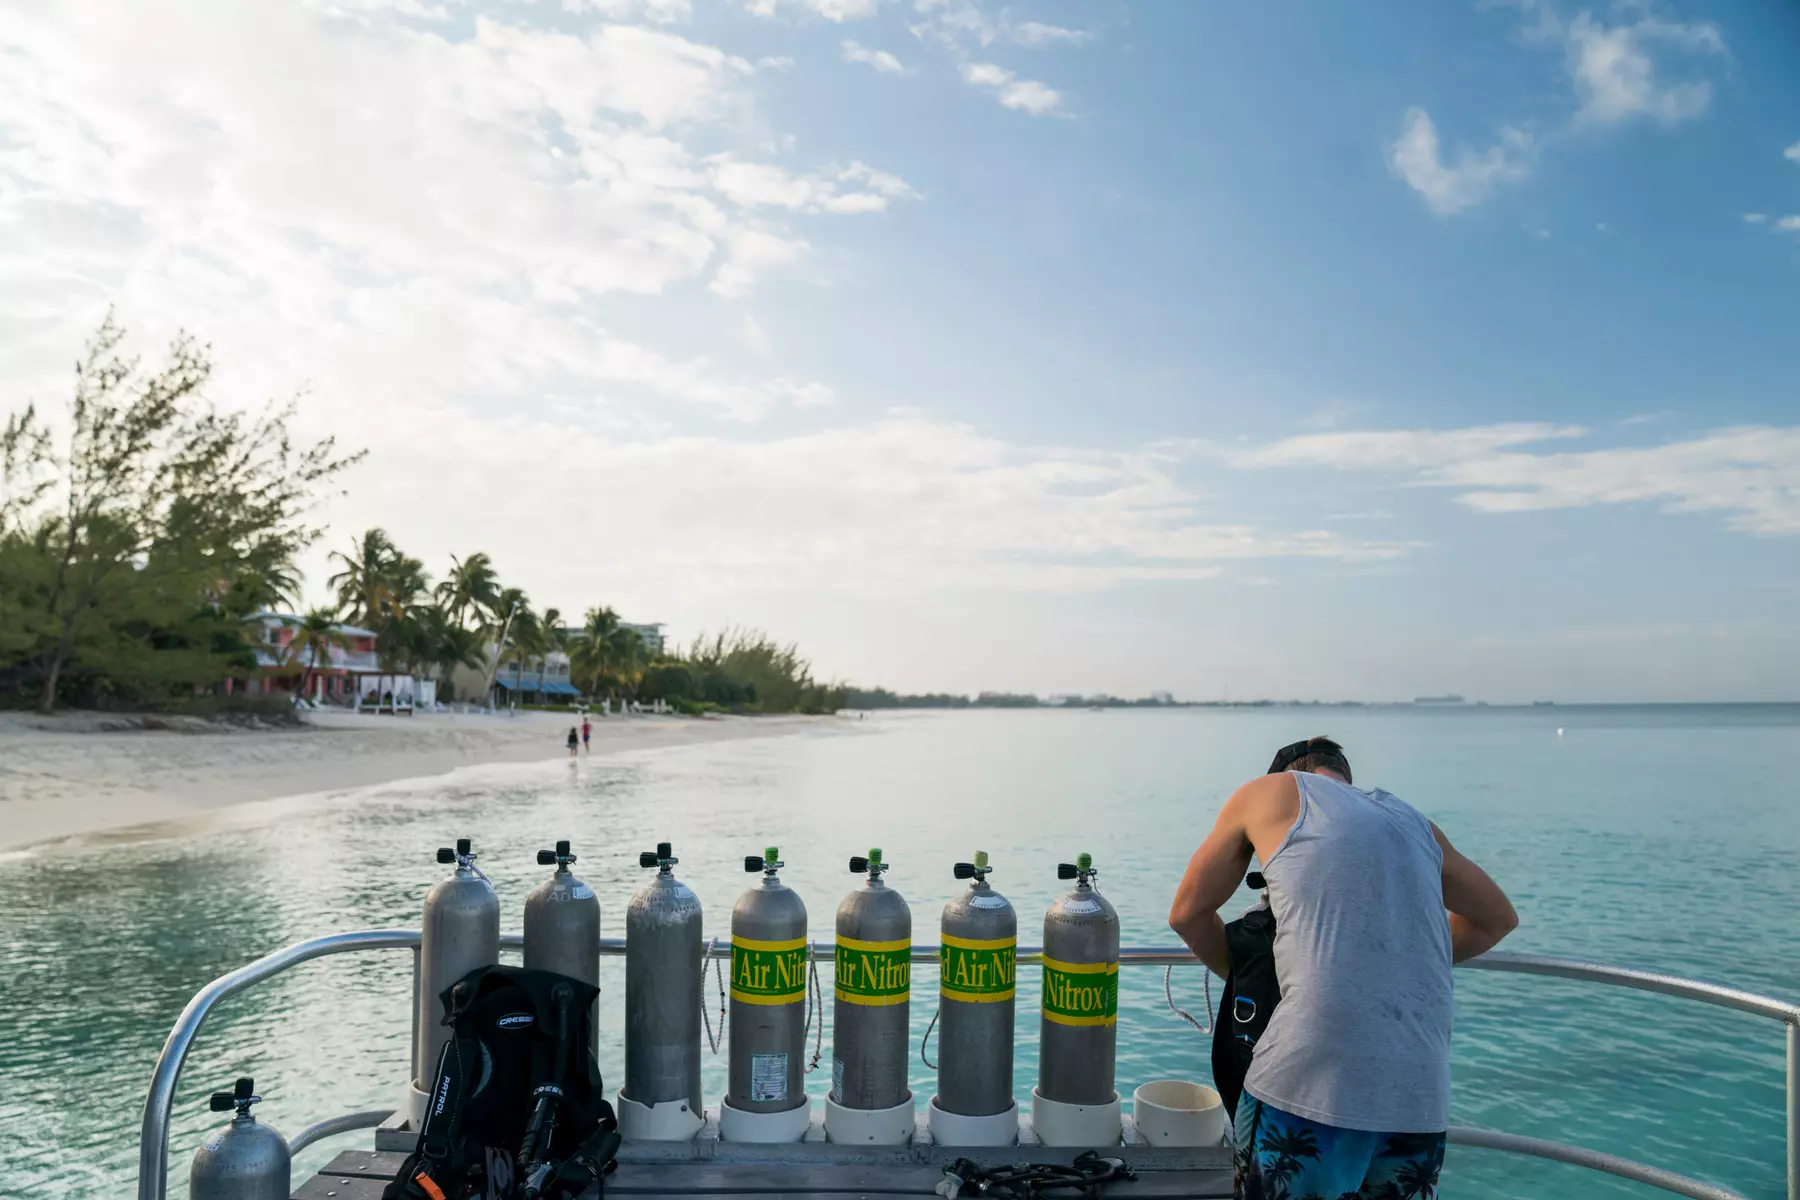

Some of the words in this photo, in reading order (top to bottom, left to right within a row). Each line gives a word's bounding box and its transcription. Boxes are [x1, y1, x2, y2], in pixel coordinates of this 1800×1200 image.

[547, 891, 570, 903] AD
[739, 952, 770, 989] Air
[954, 951, 987, 987] Air
[1045, 970, 1103, 1012] Nitrox
[499, 1016, 534, 1025] CRESSI
[434, 1075, 450, 1116] PATROL
